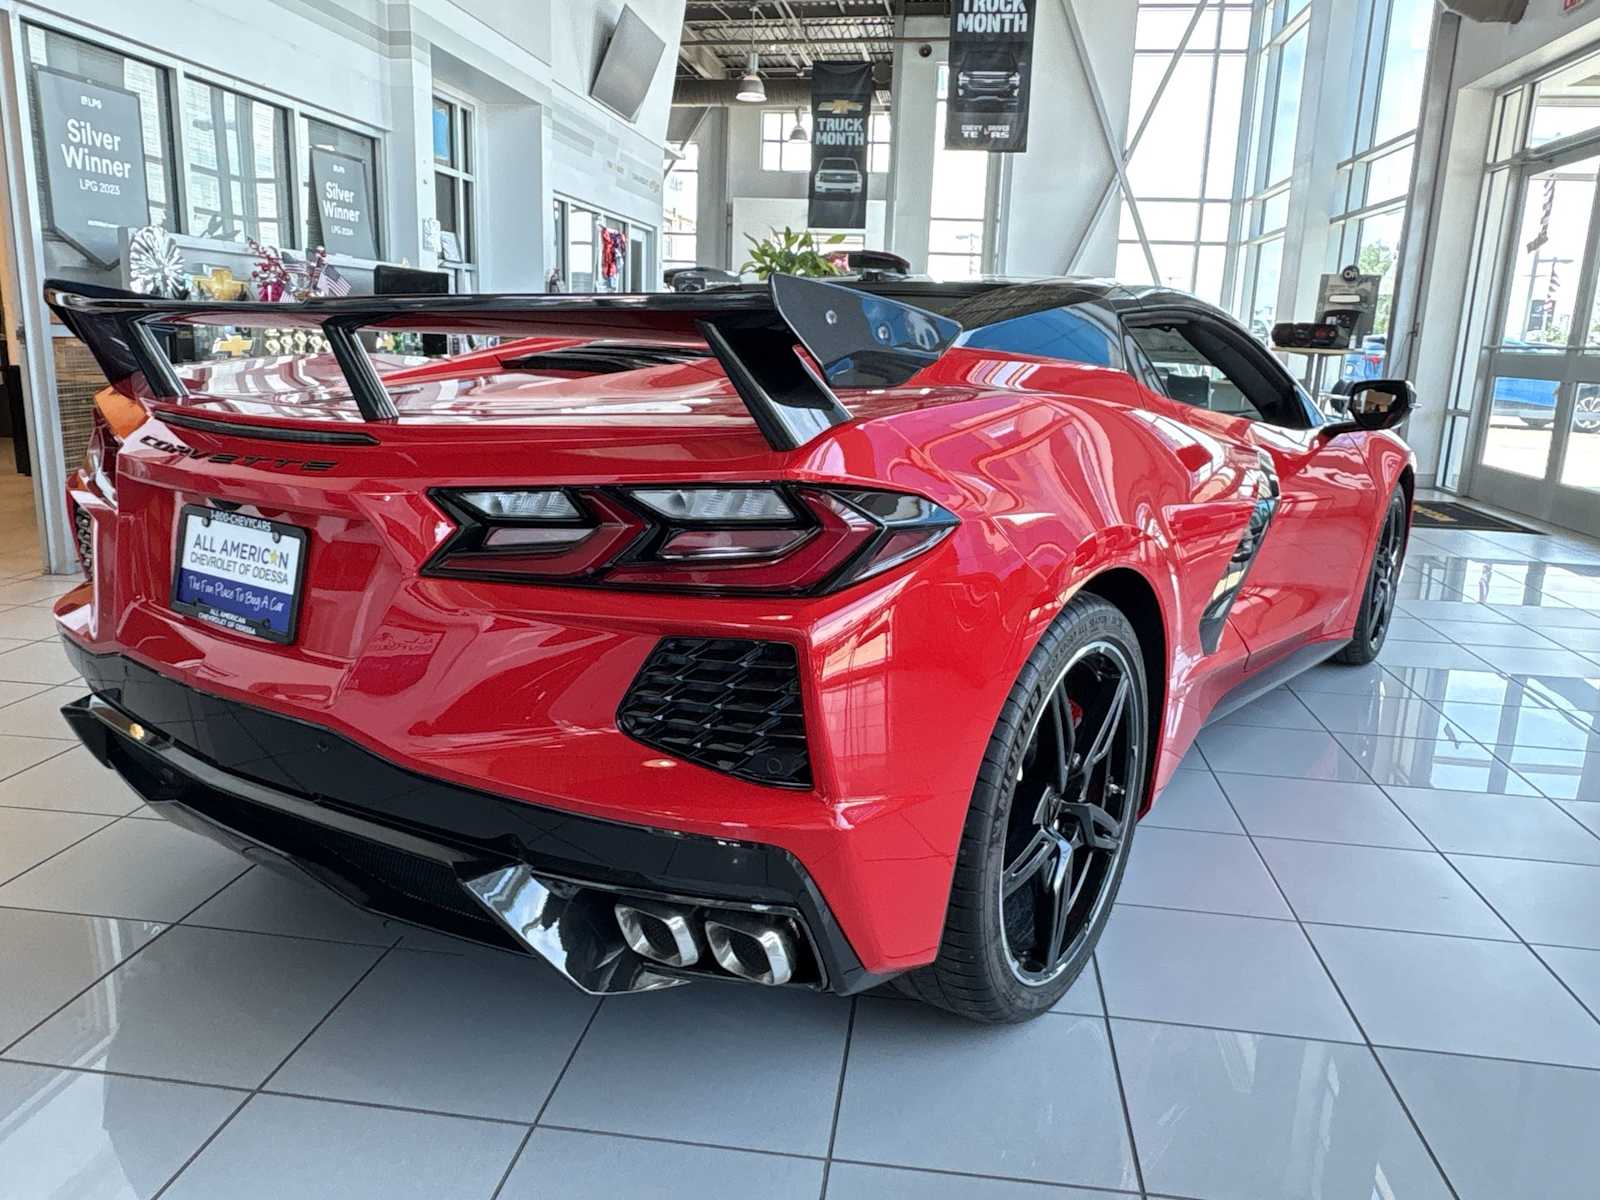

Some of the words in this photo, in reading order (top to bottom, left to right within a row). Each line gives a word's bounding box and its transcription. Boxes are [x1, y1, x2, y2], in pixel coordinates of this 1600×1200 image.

[962, 0, 1026, 12] TRUCK
[957, 13, 1028, 33] MONTH
[67, 118, 122, 151] Silver
[817, 118, 863, 131] TRUCK
[816, 132, 864, 145] MONTH
[61, 144, 132, 179] Winner
[80, 179, 98, 192] LPG
[325, 181, 354, 203] Silver
[323, 200, 360, 222] Winner
[139, 435, 336, 471] CORVETTE
[193, 534, 216, 553] ALL
[190, 552, 238, 573] CHEVROLET
[240, 563, 251, 576] OF
[252, 566, 288, 585] ODESSA
[188, 575, 200, 590] The
[201, 580, 214, 593] Fun
[215, 582, 234, 600] Place
[235, 588, 243, 602] To
[244, 591, 261, 611] Buy
[261, 595, 268, 609] A
[270, 597, 284, 612] Car
[998, 683, 1042, 811] MICHELIN
